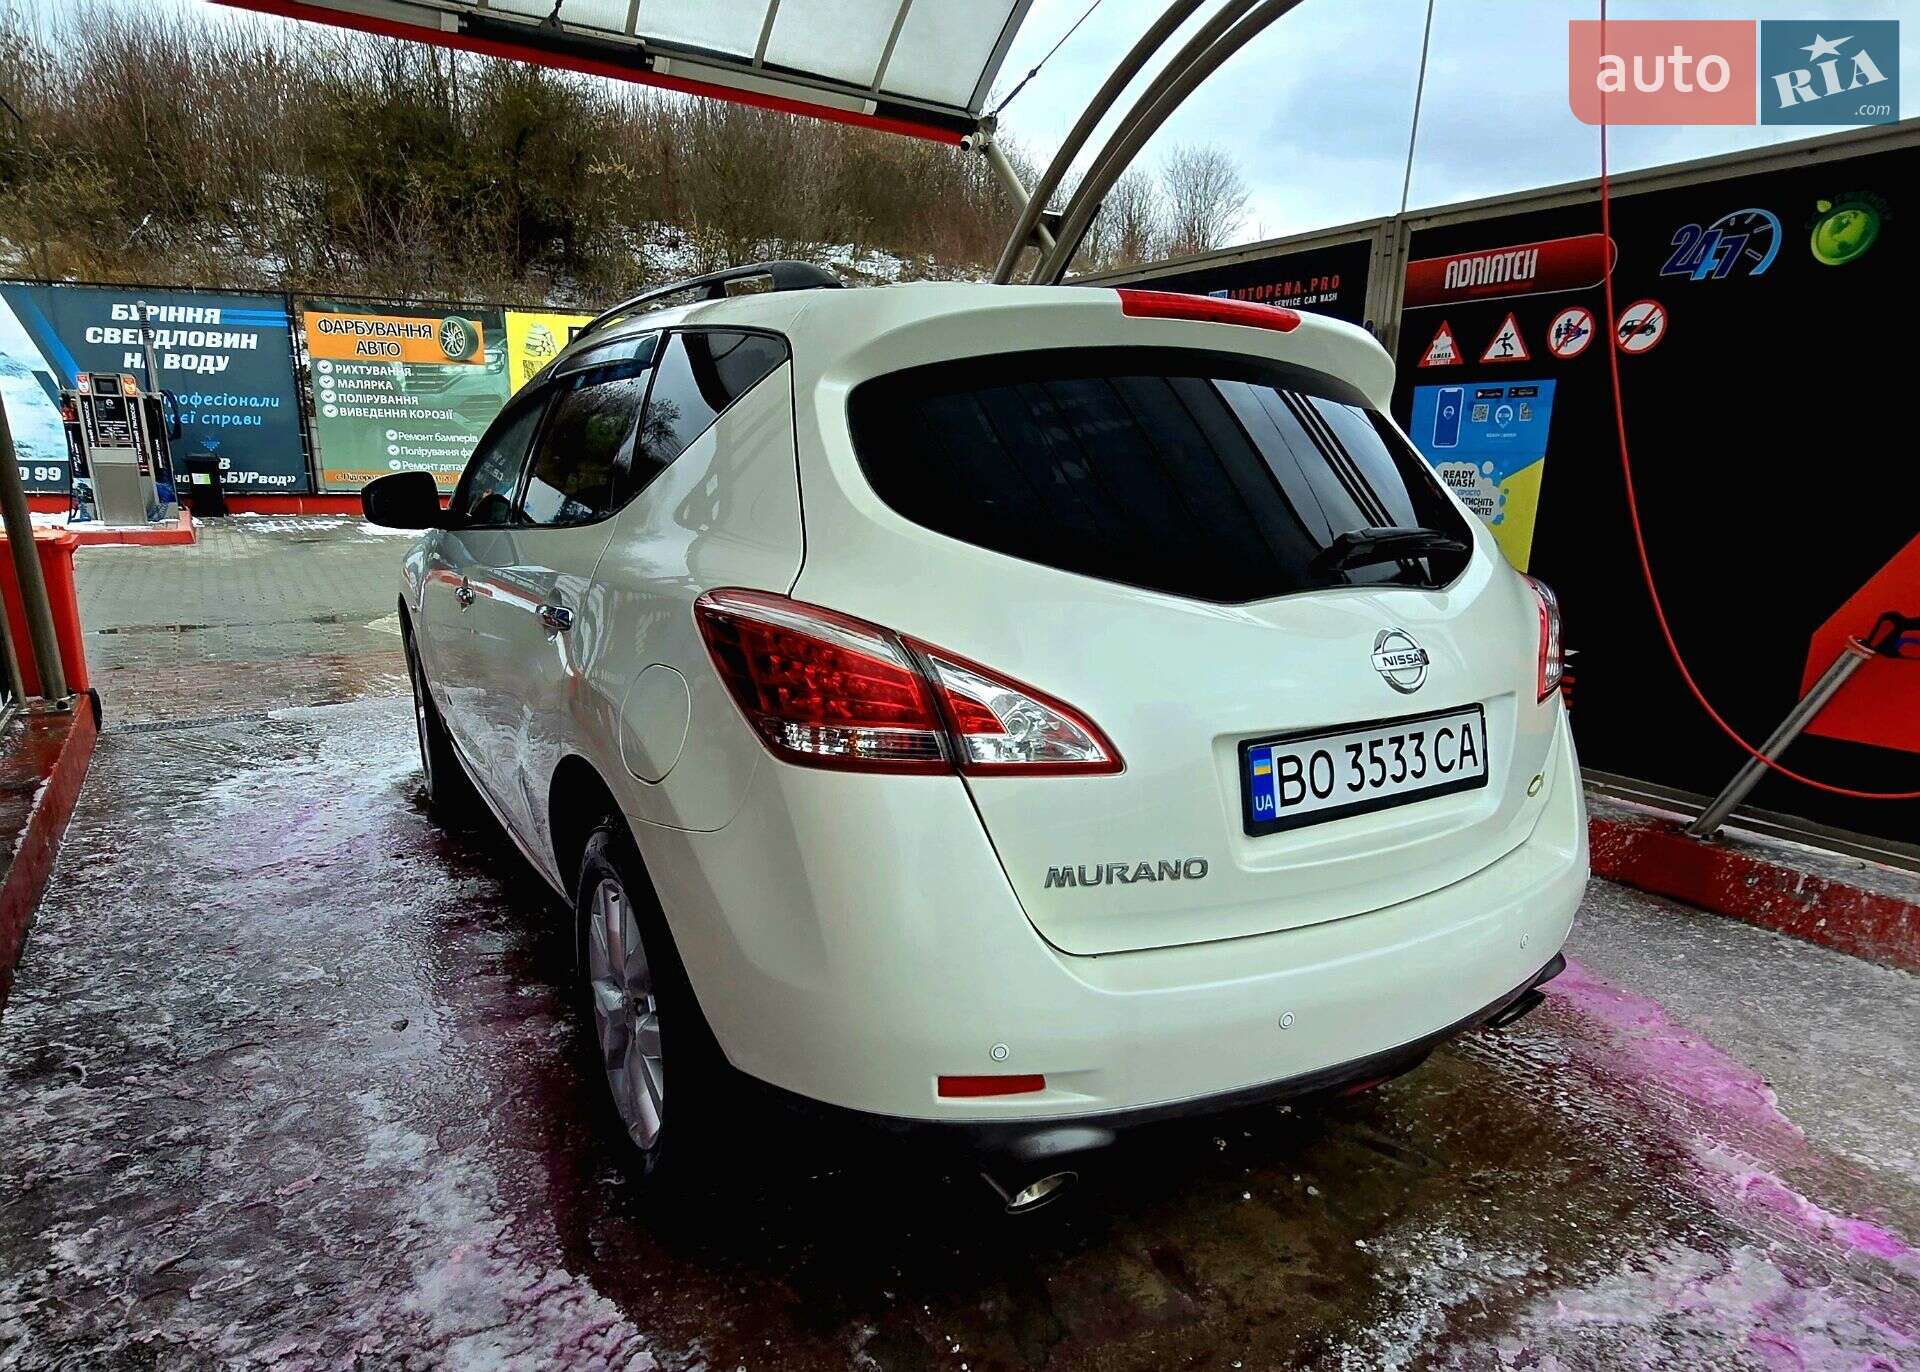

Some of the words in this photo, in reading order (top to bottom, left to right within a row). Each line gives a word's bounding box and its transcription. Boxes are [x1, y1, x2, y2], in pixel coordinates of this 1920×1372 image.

[1304, 295, 1317, 304] CAR
[1320, 292, 1338, 303] WASH
[111, 303, 222, 325] БУРІННЯ
[317, 318, 434, 339] ФАРБУВАННЯ
[355, 340, 402, 357] АВТО
[163, 353, 230, 374] ВОДУ
[337, 379, 394, 391] МАЛЯРКА
[338, 393, 419, 406] ПОЛІРУВАННЯ
[201, 413, 262, 428] справи
[339, 407, 408, 419] ВИВЕДЕННЯ
[409, 409, 454, 420] КОРОЗІЇ
[398, 431, 434, 442] Ремонт
[400, 447, 460, 458] Полірування
[401, 461, 438, 471] Ремонт
[34, 466, 61, 482] 99
[1443, 470, 1475, 479] READY
[1447, 479, 1475, 488] WASH
[1276, 745, 1335, 808] BO
[1345, 732, 1427, 792] 3533
[1434, 722, 1478, 774] CA
[1255, 794, 1274, 812] UA
[1044, 856, 1209, 889] MURANO
